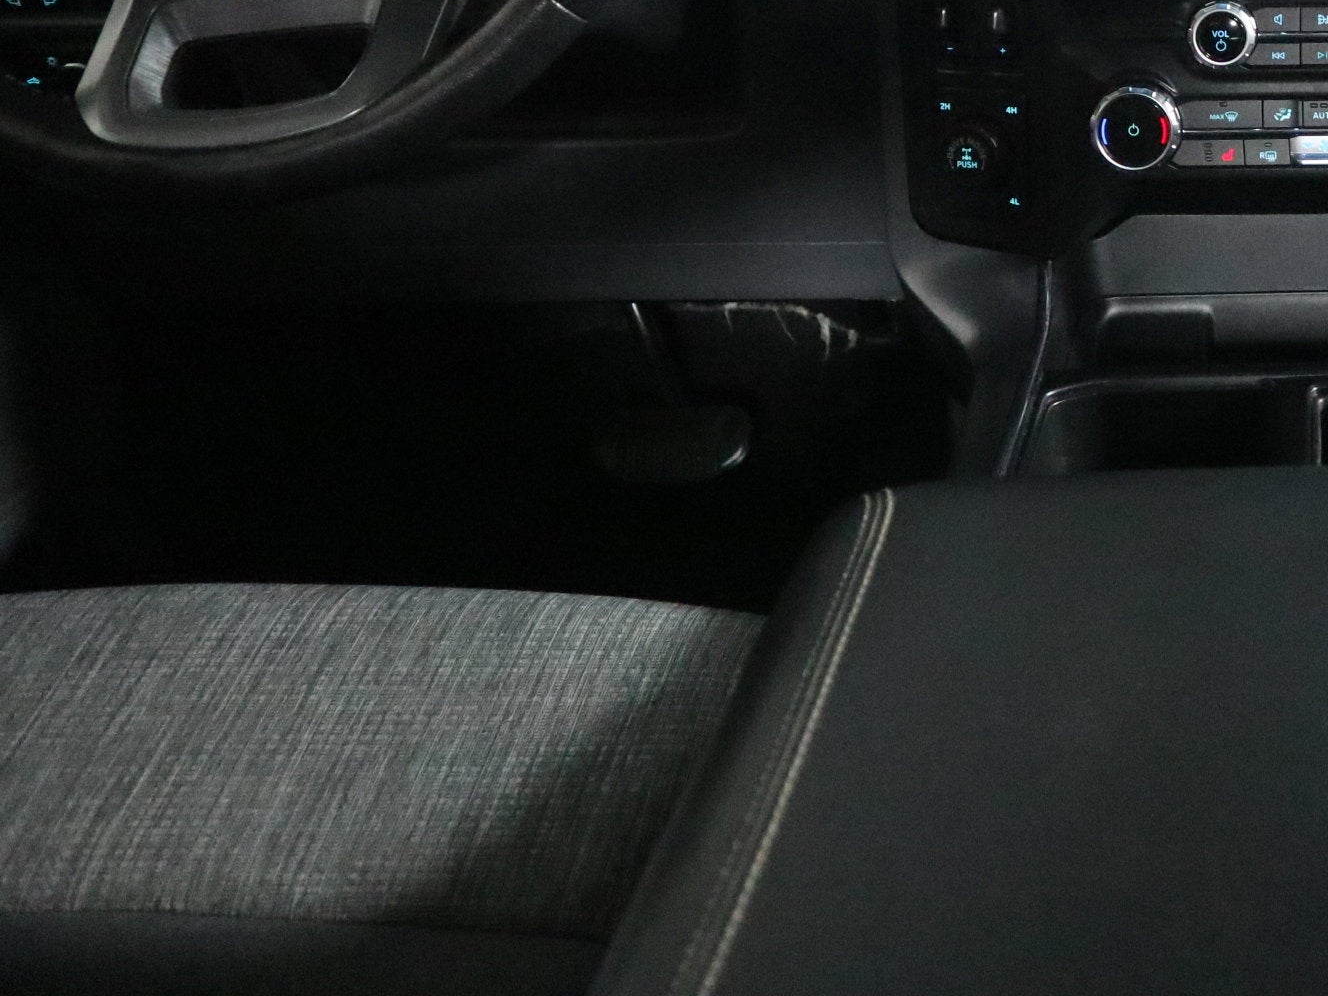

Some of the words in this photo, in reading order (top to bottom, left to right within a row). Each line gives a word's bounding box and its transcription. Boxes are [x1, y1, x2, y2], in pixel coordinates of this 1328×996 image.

[1212, 30, 1229, 38] VOL
[940, 102, 950, 110] 2H
[1006, 106, 1017, 114] 4H
[956, 160, 978, 169] PUSH
[1009, 197, 1020, 206] 4L
